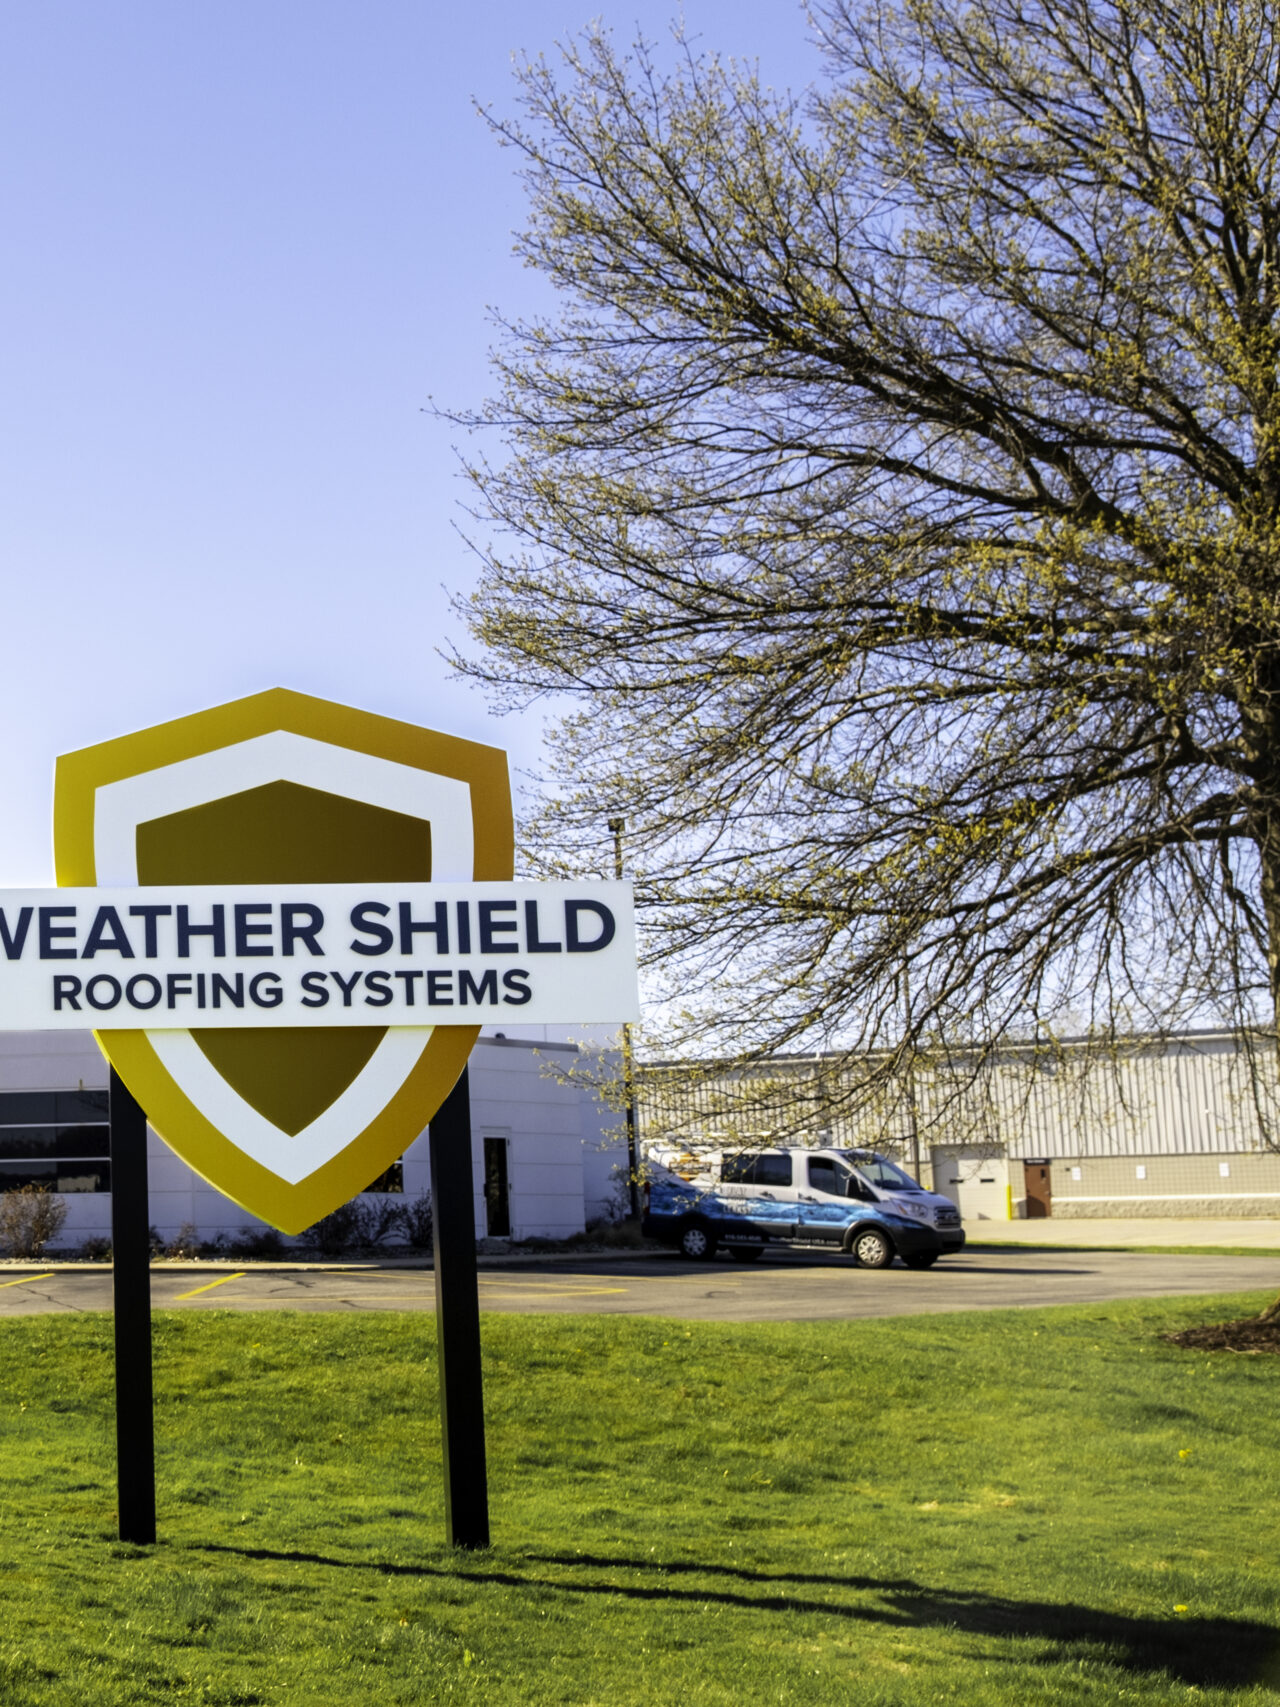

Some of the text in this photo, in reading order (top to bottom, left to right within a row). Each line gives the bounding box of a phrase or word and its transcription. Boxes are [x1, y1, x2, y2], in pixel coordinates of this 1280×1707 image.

[349, 899, 616, 957] SHIELD
[53, 968, 533, 1011] ROOFING SYSTEMS
